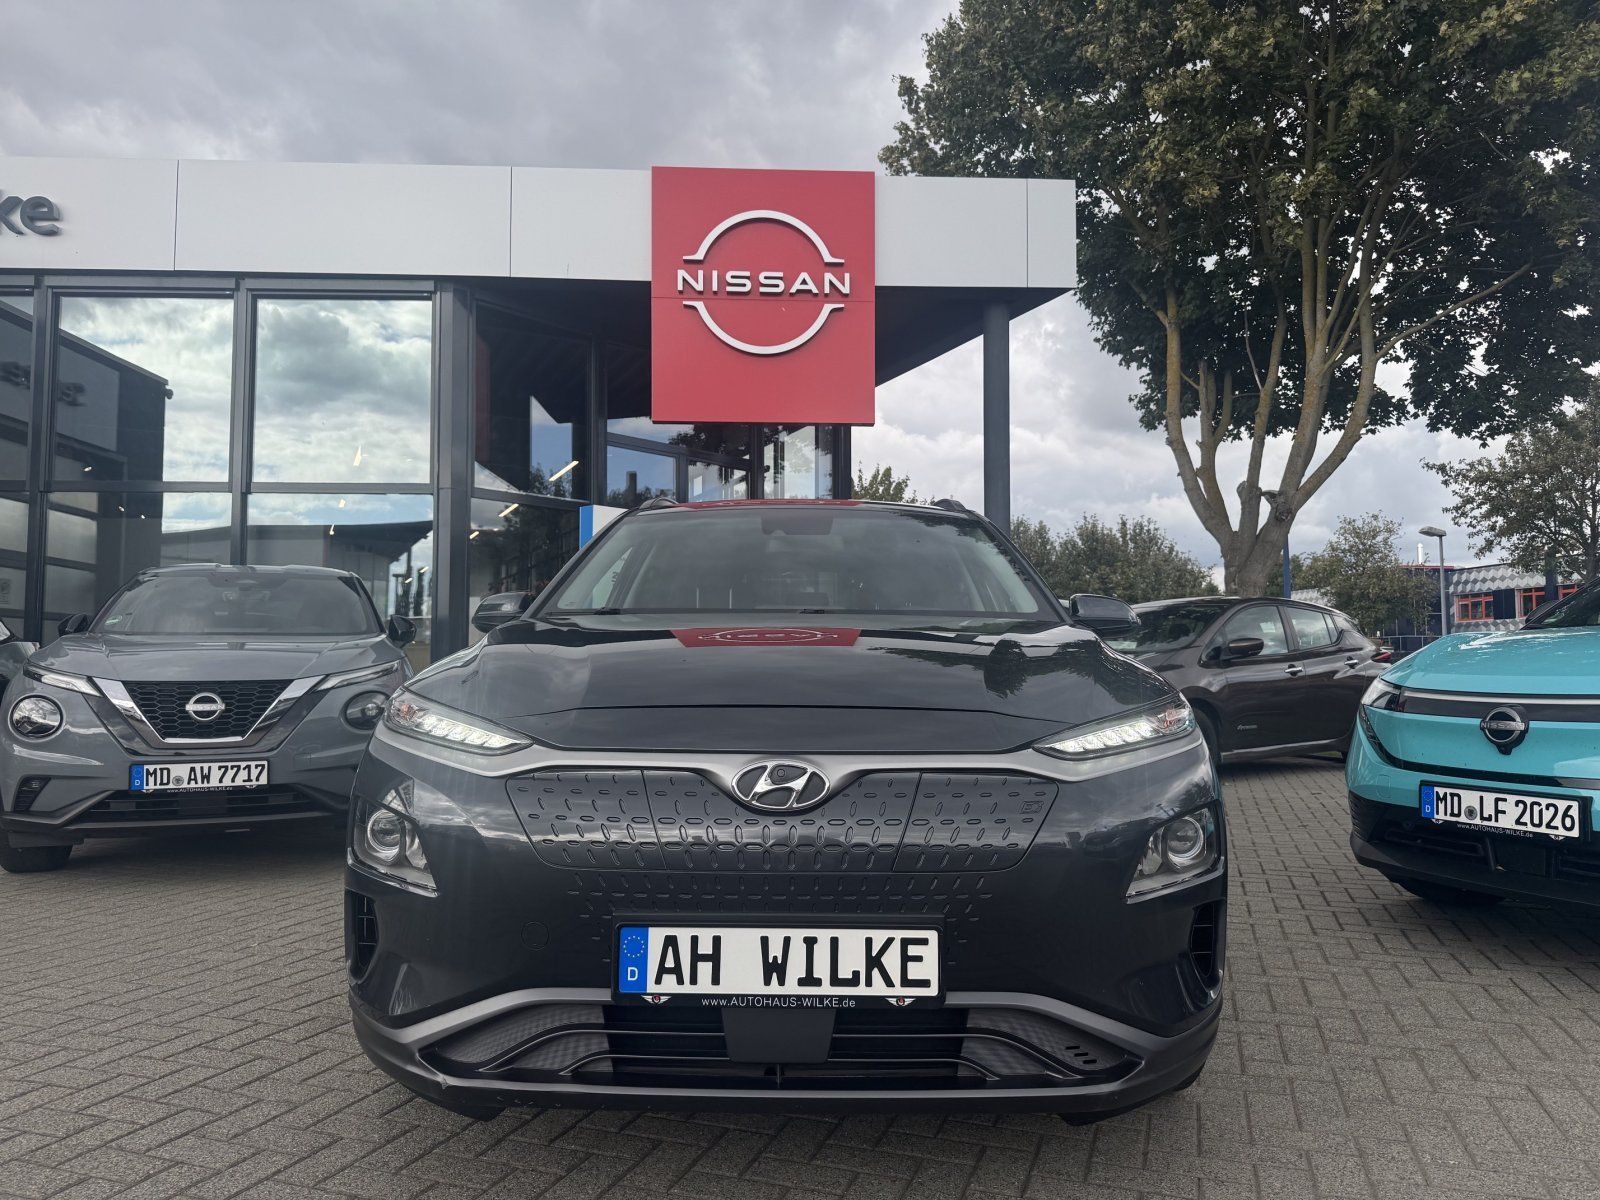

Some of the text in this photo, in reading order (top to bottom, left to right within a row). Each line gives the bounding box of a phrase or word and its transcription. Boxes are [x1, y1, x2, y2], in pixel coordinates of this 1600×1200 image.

[677, 269, 850, 297] NISSAN
[145, 767, 171, 787] MD
[187, 765, 212, 785] AW
[218, 763, 266, 783] 7717
[1425, 790, 1576, 832] D MD LF 2026
[627, 934, 932, 988] D AH WILKE
[701, 996, 856, 1008] www.AUTOHAUS-WILKE.de
